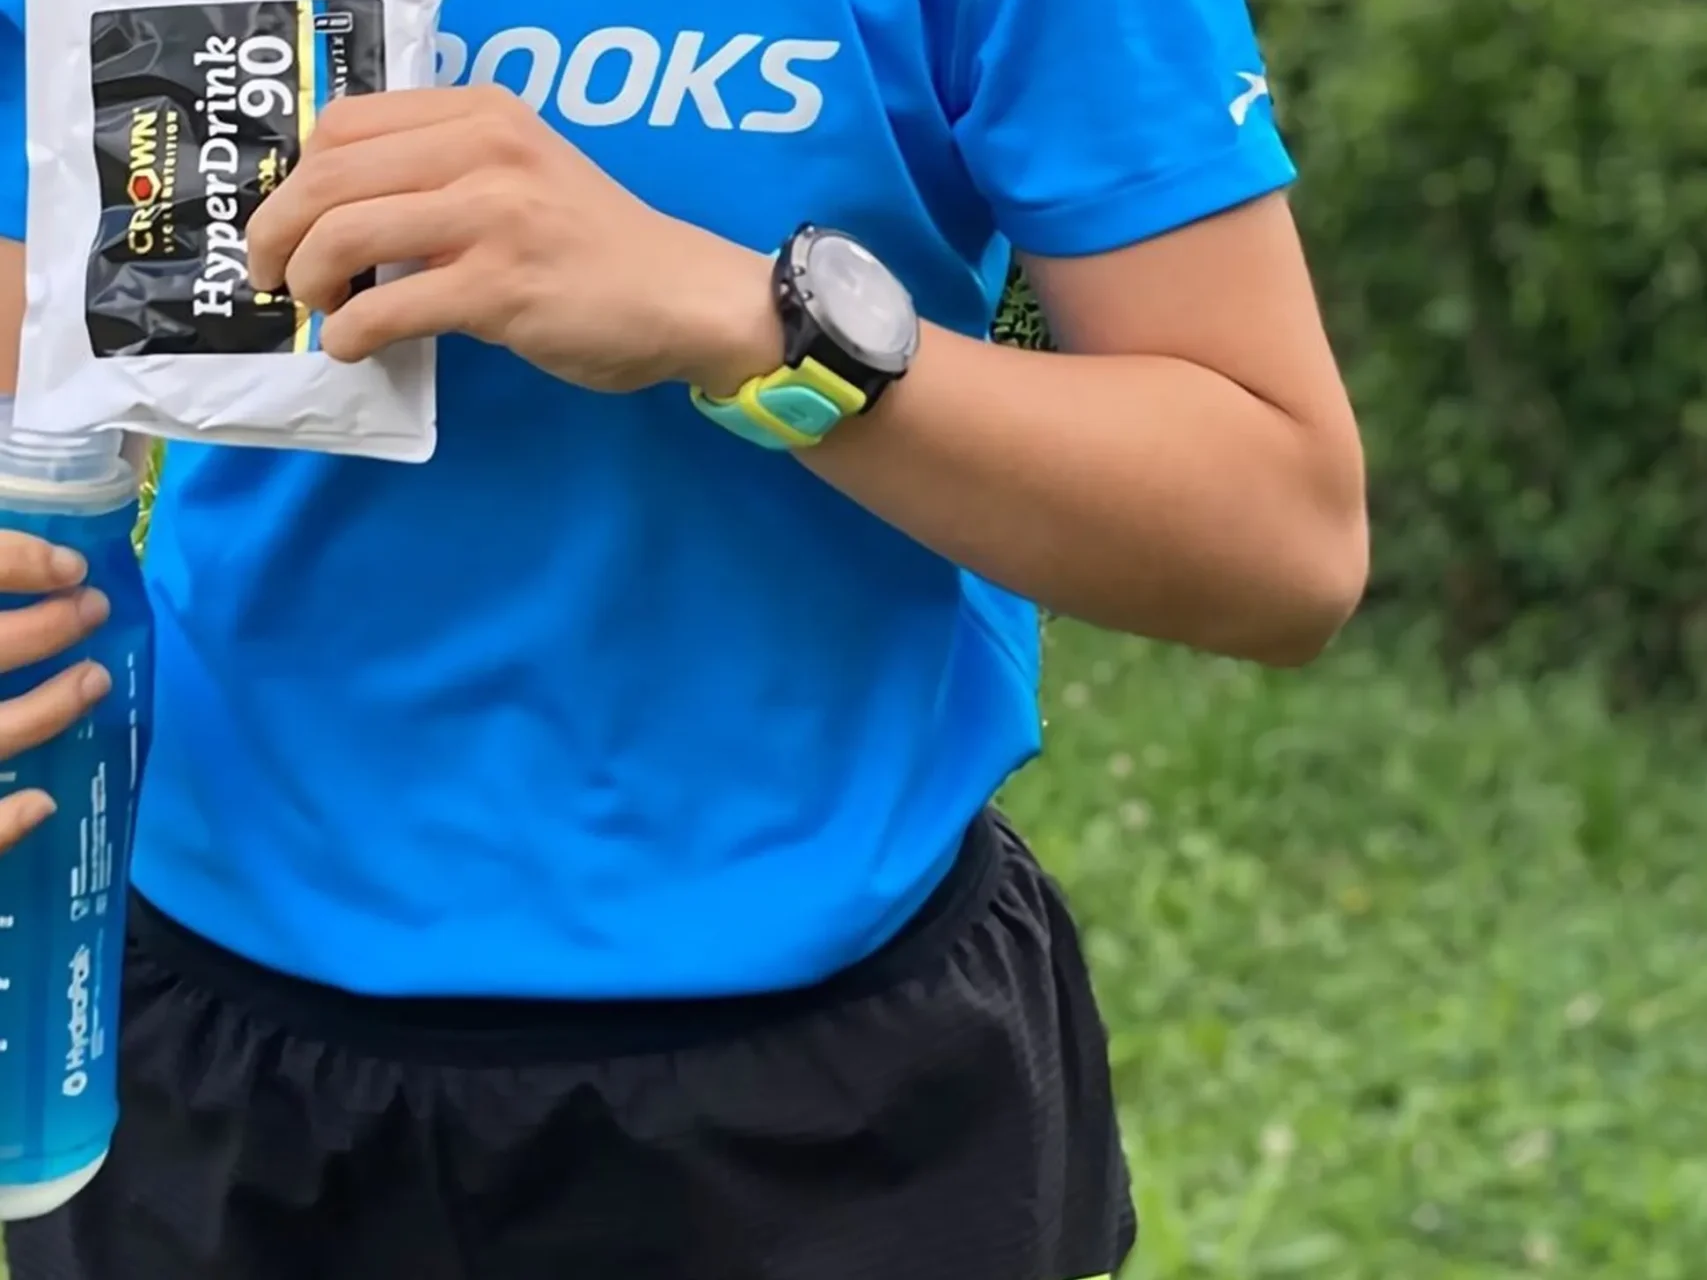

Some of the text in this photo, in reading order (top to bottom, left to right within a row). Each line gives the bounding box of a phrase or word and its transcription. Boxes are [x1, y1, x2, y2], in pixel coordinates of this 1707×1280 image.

[238, 35, 294, 118] 90
[127, 111, 161, 254] CROWN
[193, 35, 249, 317] HyperDrink
